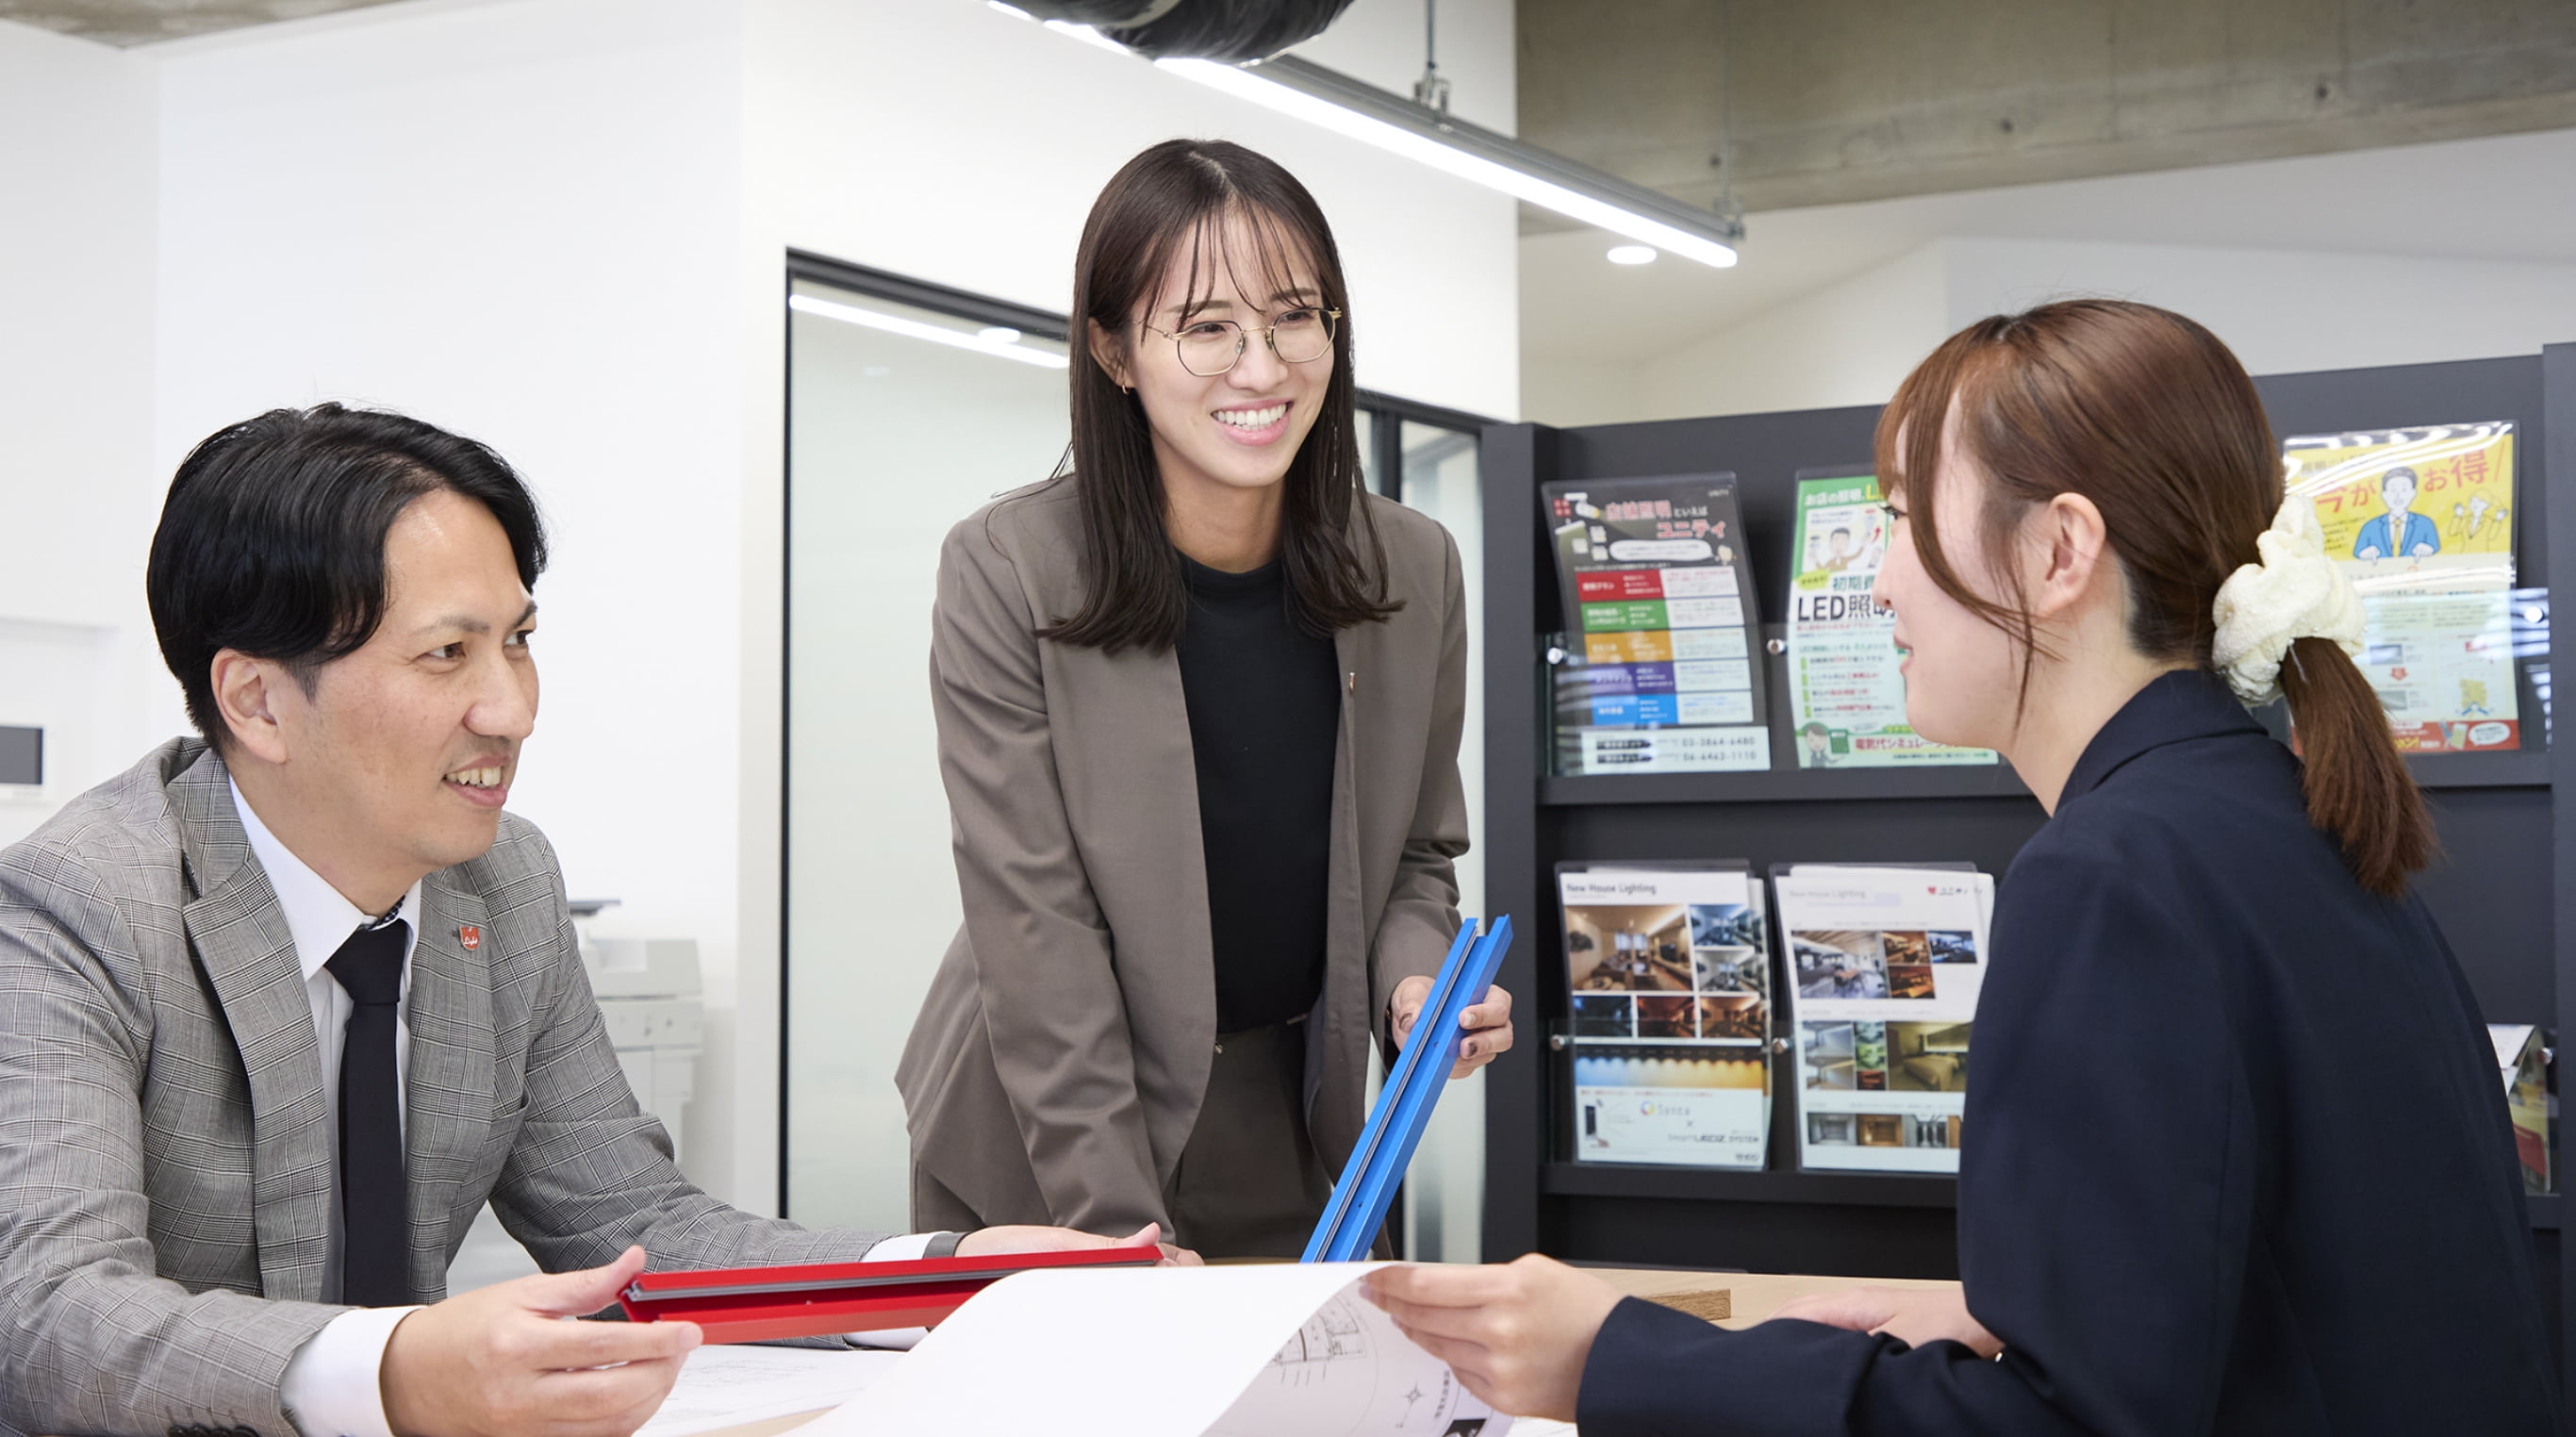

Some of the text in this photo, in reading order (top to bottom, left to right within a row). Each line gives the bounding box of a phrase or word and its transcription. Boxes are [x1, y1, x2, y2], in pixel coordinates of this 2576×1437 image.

[2423, 449, 2491, 493] お得
[1657, 520, 1726, 539] ユニティ
[1589, 883, 1616, 892] House
[1619, 883, 1657, 894] Lighting
